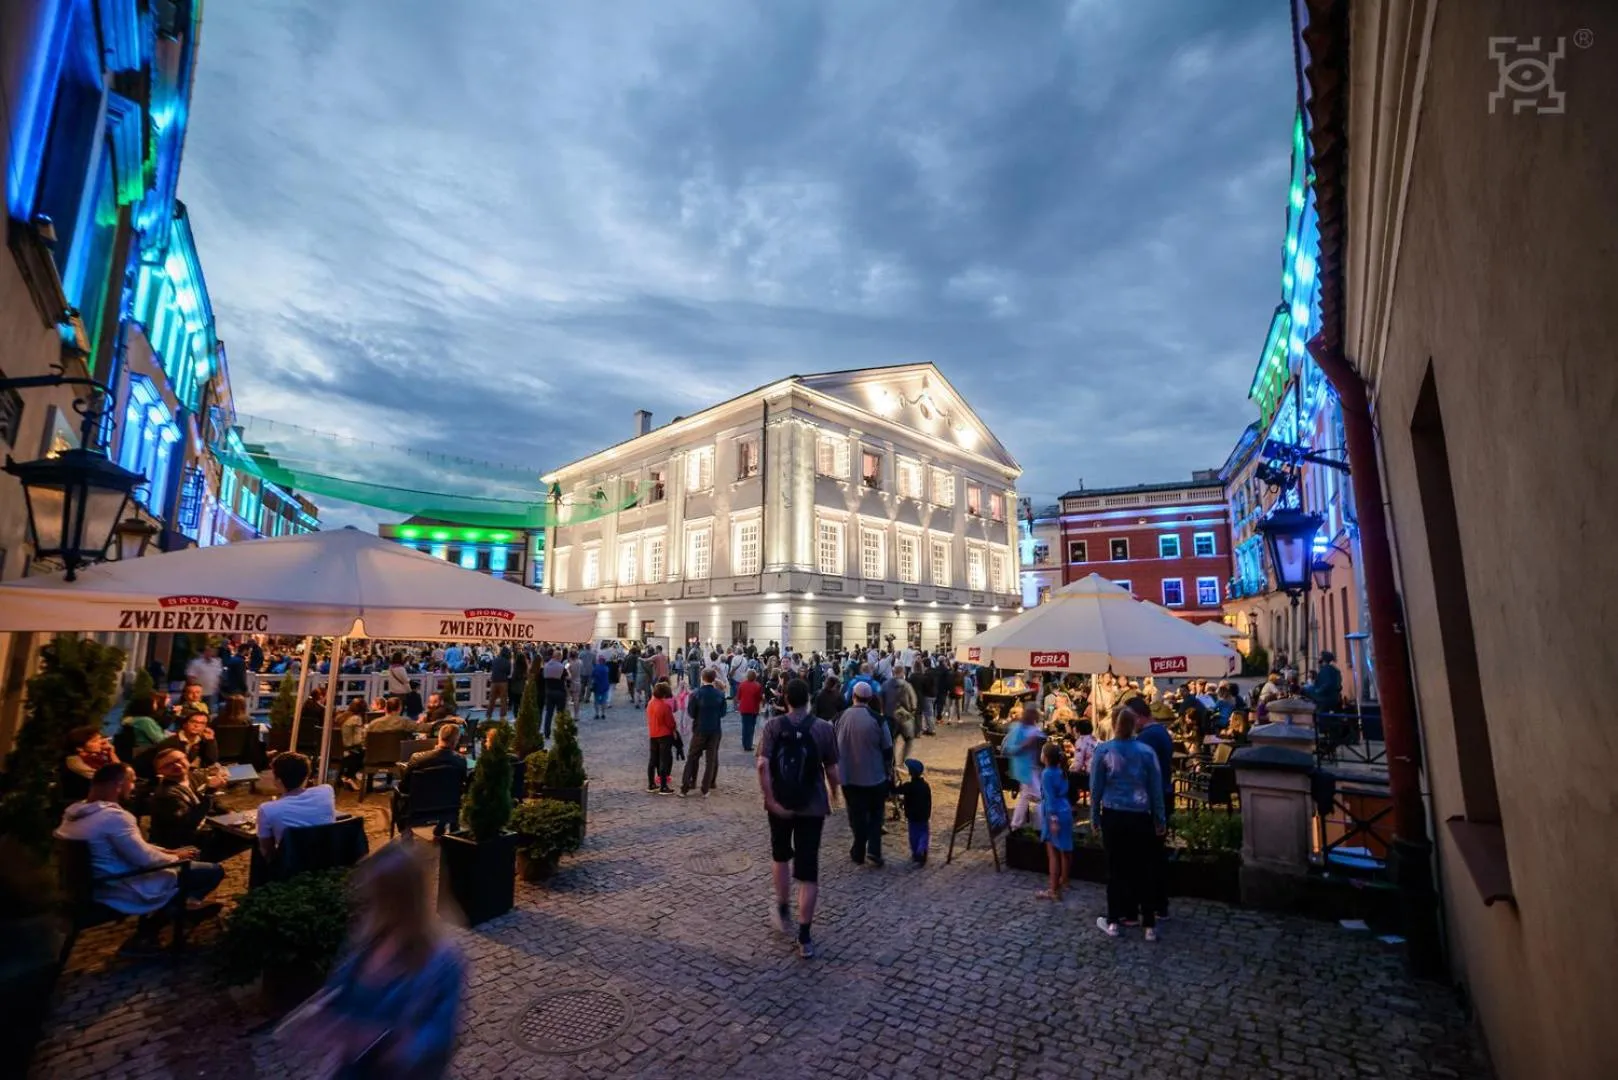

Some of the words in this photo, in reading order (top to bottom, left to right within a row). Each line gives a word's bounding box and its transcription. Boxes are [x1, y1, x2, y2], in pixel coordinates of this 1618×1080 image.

[167, 596, 231, 608] BROWAR
[118, 610, 269, 632] ZWIERZYNIEC
[469, 610, 510, 619] BROWAR
[439, 620, 535, 639] ZWIERZYNIEC
